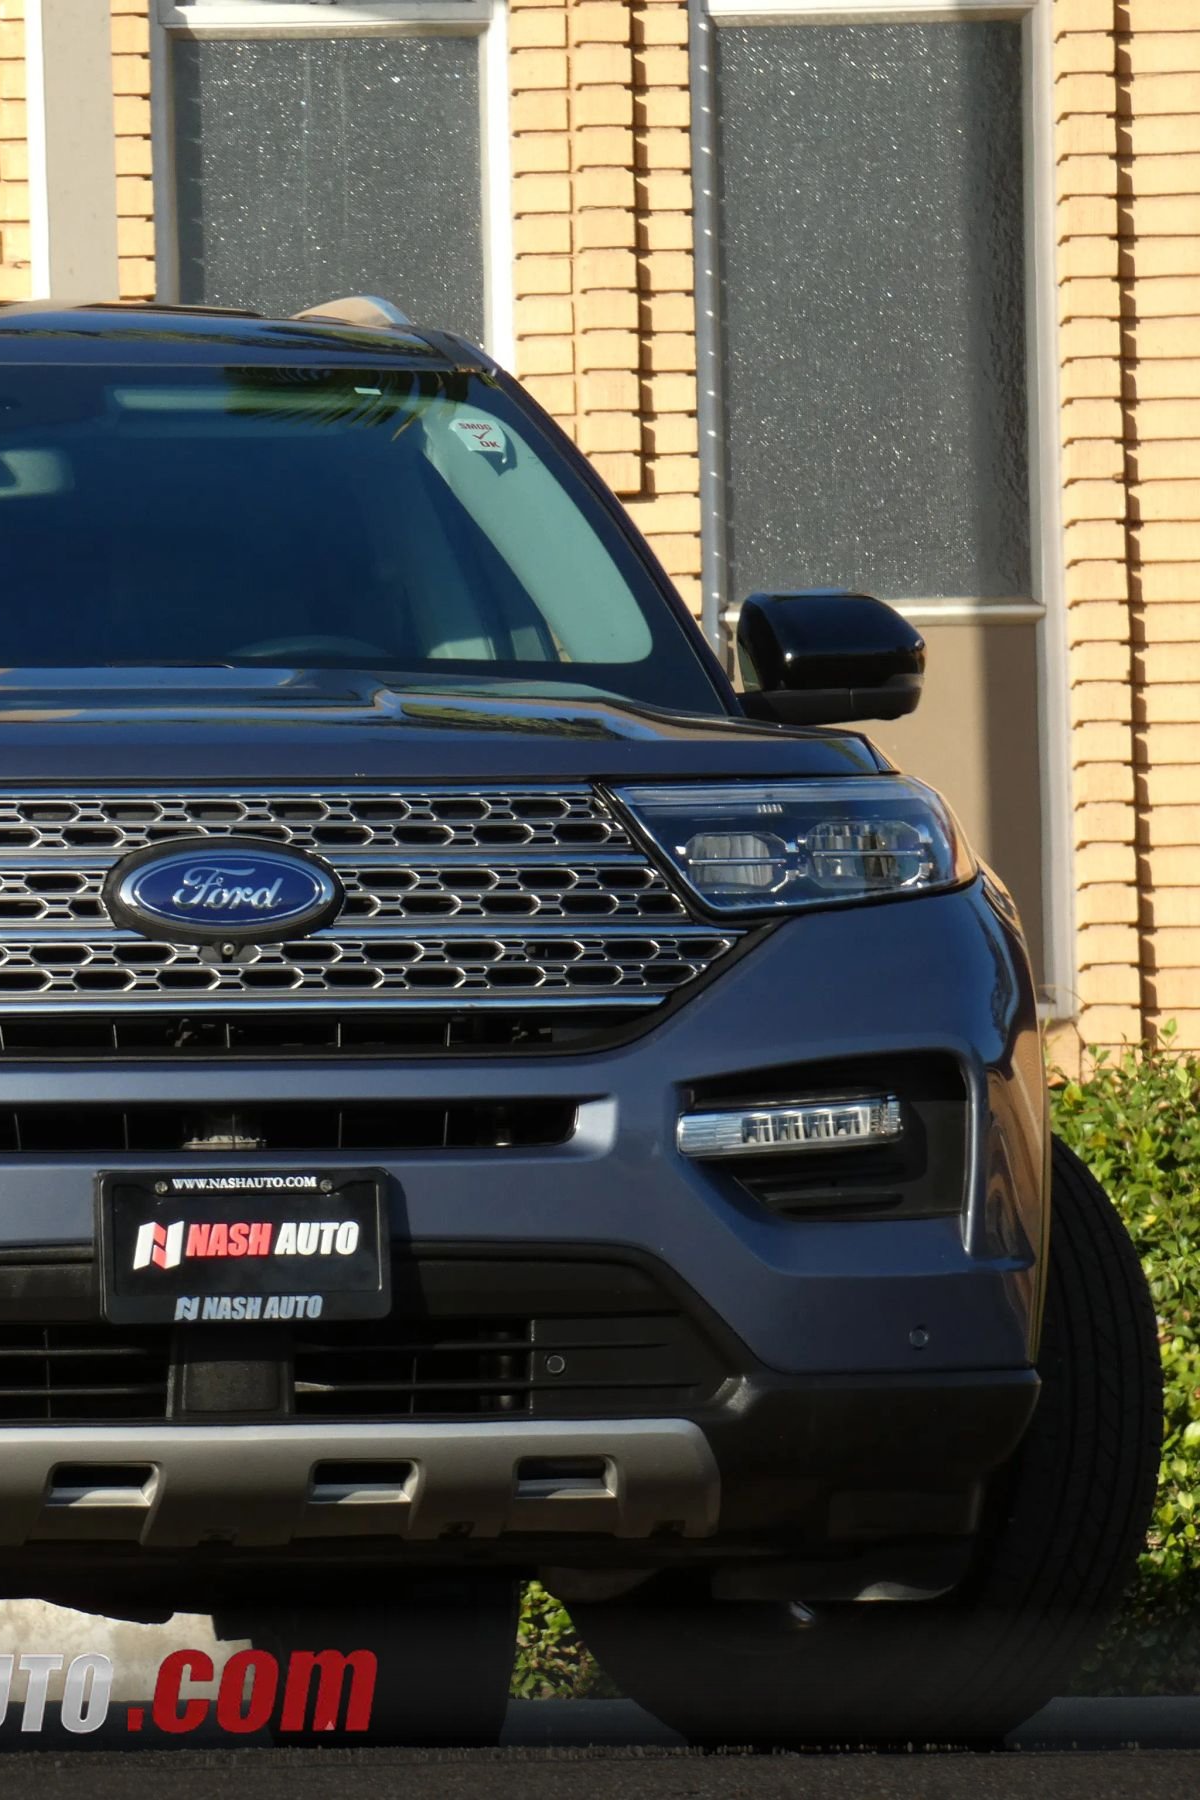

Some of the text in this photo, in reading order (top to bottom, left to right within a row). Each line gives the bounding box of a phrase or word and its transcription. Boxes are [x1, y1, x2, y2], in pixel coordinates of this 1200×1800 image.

[458, 422, 492, 431] SMOG
[479, 440, 501, 448] OK
[172, 866, 284, 910] Ford
[171, 1175, 317, 1190] WWW.NASHAUTO.COM
[186, 1222, 274, 1257] NASH
[274, 1220, 360, 1256] AUTO
[201, 1296, 266, 1320] NASH
[262, 1294, 324, 1320] AUTO
